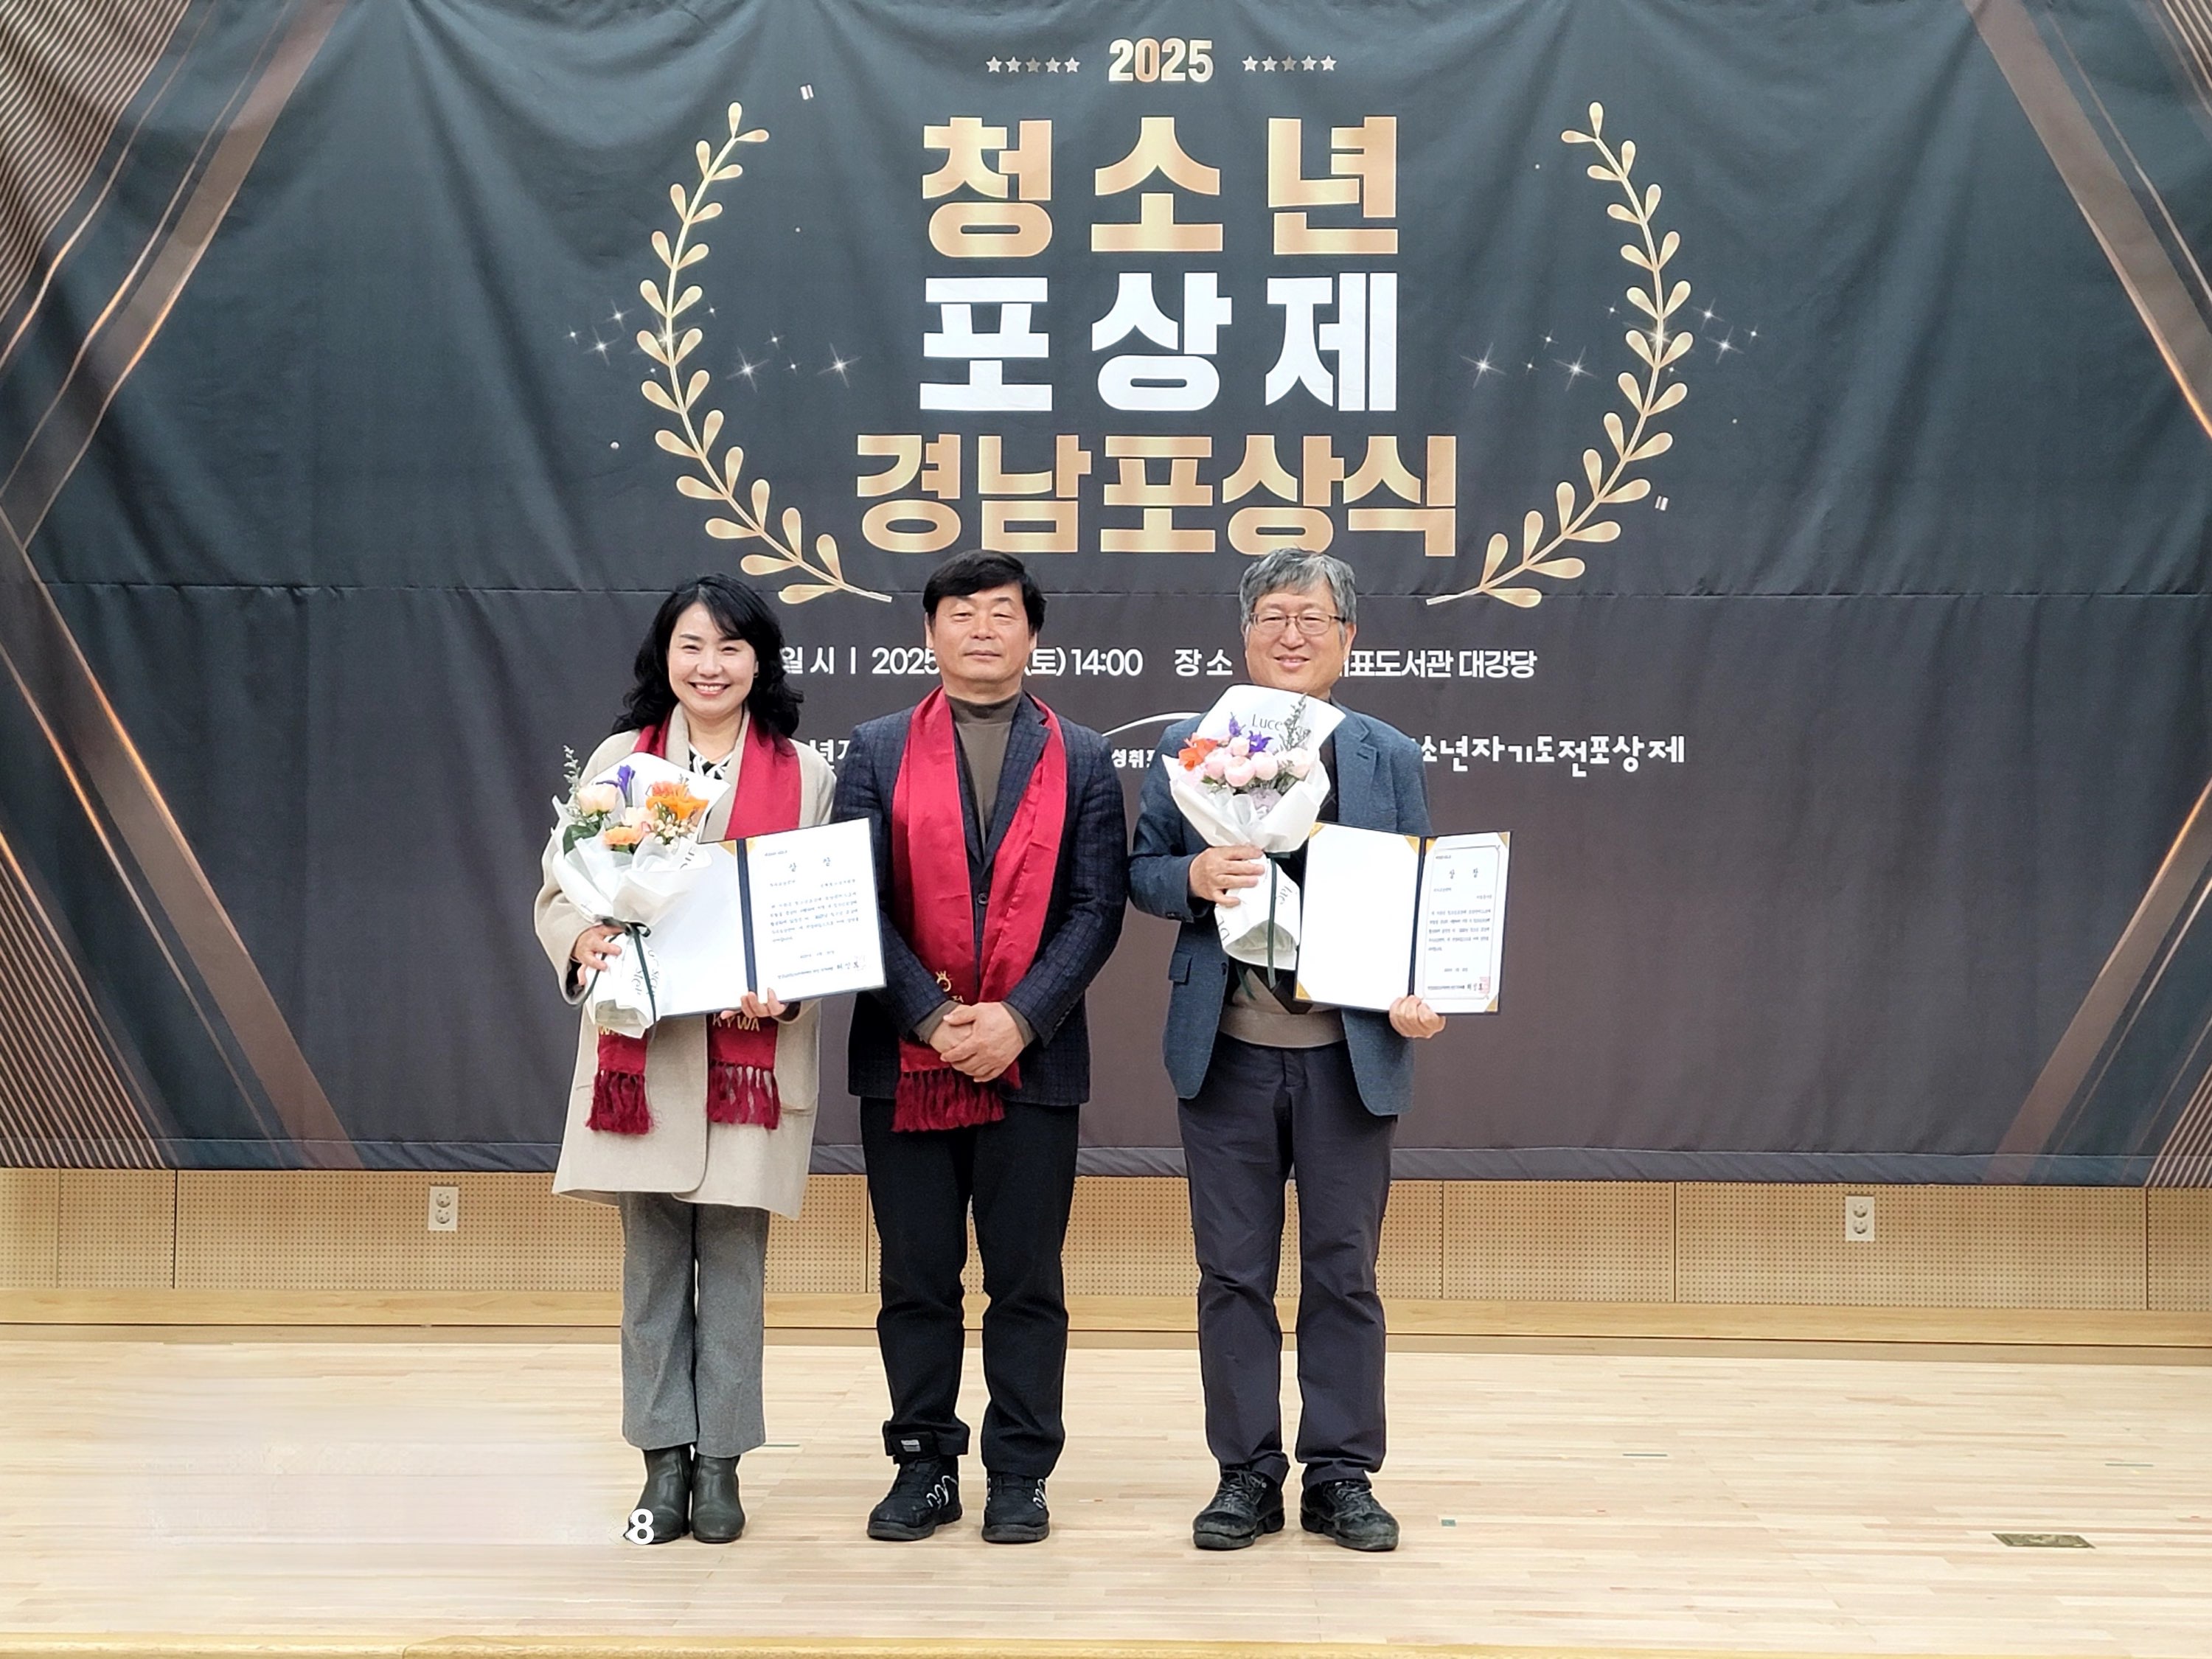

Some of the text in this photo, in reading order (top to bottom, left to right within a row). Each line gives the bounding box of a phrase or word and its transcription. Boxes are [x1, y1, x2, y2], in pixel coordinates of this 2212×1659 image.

[1108, 38, 1214, 83] 2025
[857, 434, 1457, 557] 경남포상식
[1340, 650, 1454, 678] 표도서관
[1459, 650, 1537, 678] 대강당
[1412, 735, 1685, 776] 소년자기도전포상제
[712, 1012, 760, 1032] KYWA
